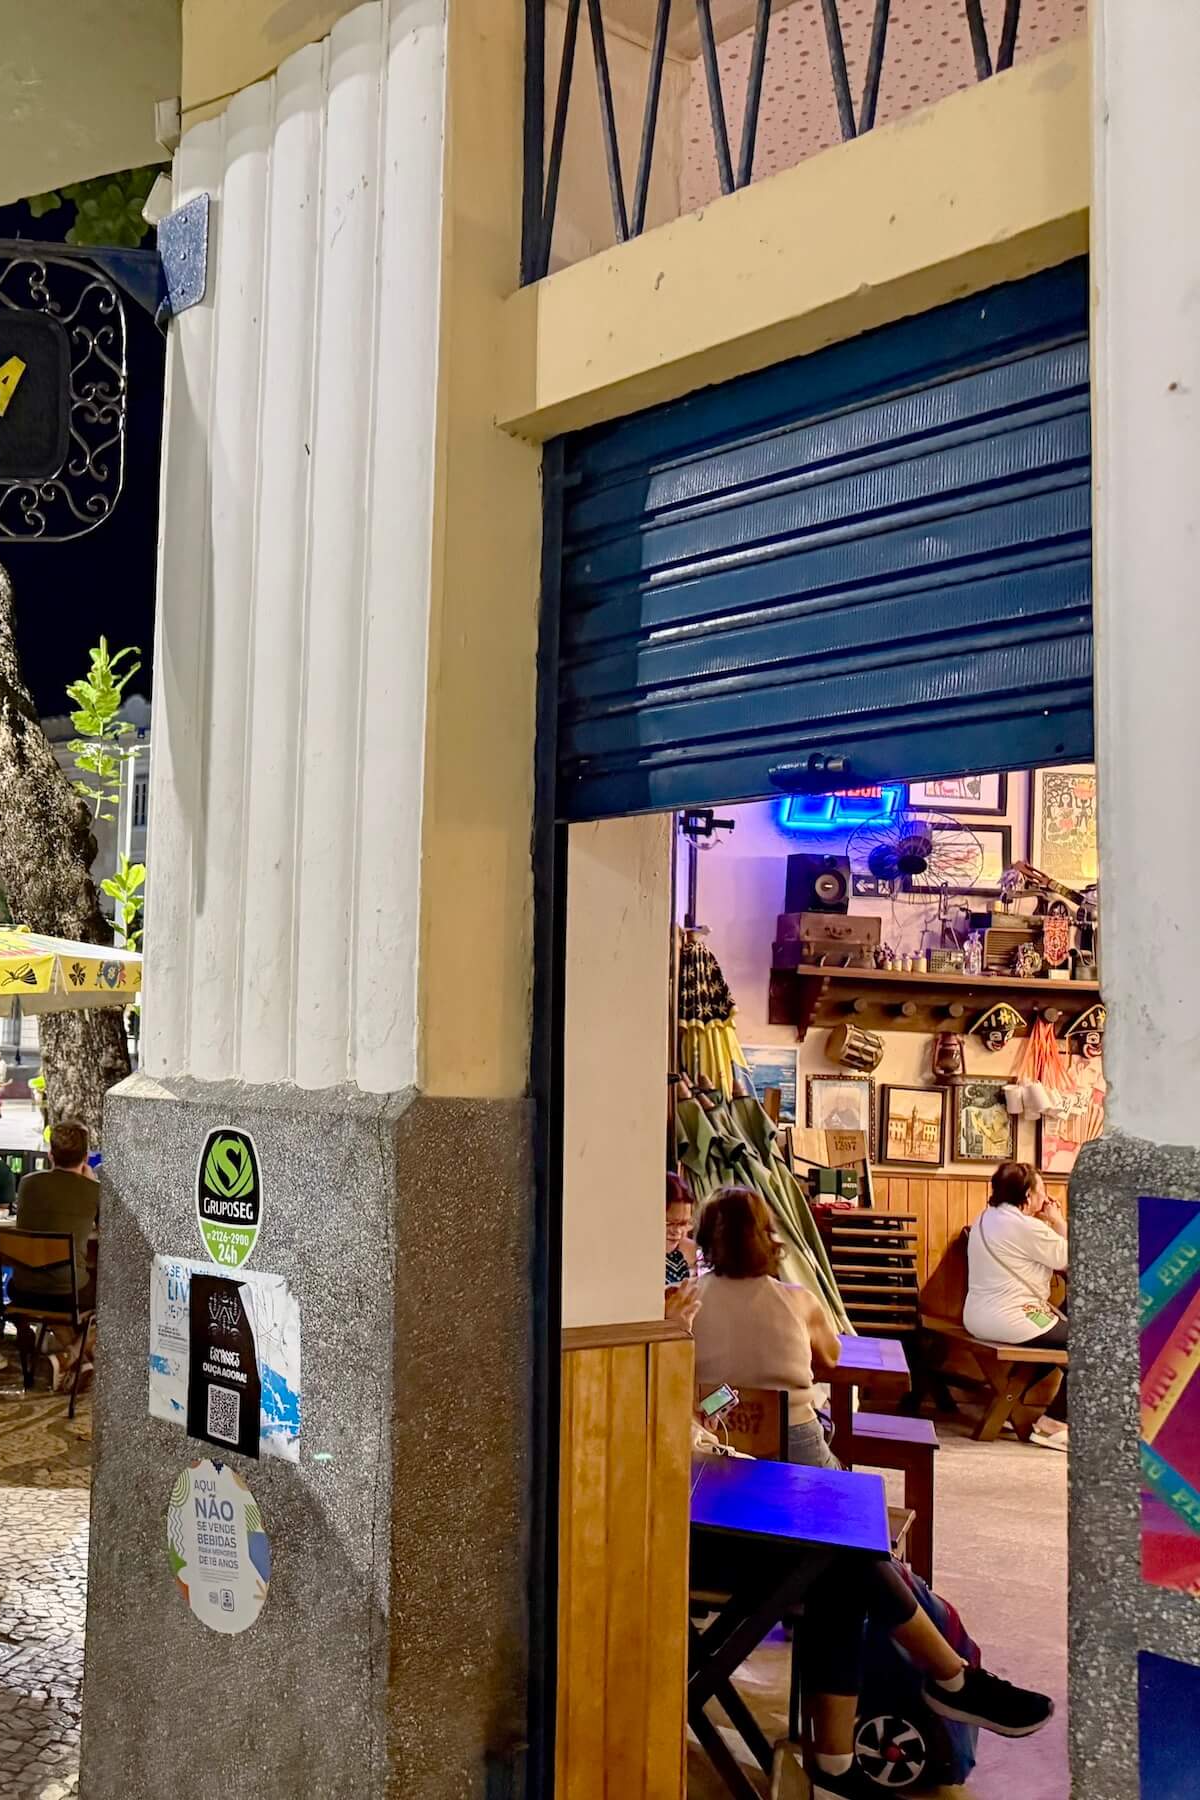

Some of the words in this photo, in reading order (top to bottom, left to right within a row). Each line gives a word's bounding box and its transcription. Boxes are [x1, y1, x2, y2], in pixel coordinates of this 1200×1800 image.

[218, 1243, 238, 1265] 24h
[194, 1479, 216, 1492] AQUI
[195, 1494, 234, 1522] NÃO
[196, 1520, 208, 1531] SE
[208, 1521, 236, 1535] VENDE
[197, 1533, 237, 1549] BEBIDAS
[199, 1554, 209, 1566] DE
[218, 1558, 239, 1570] ANOS
